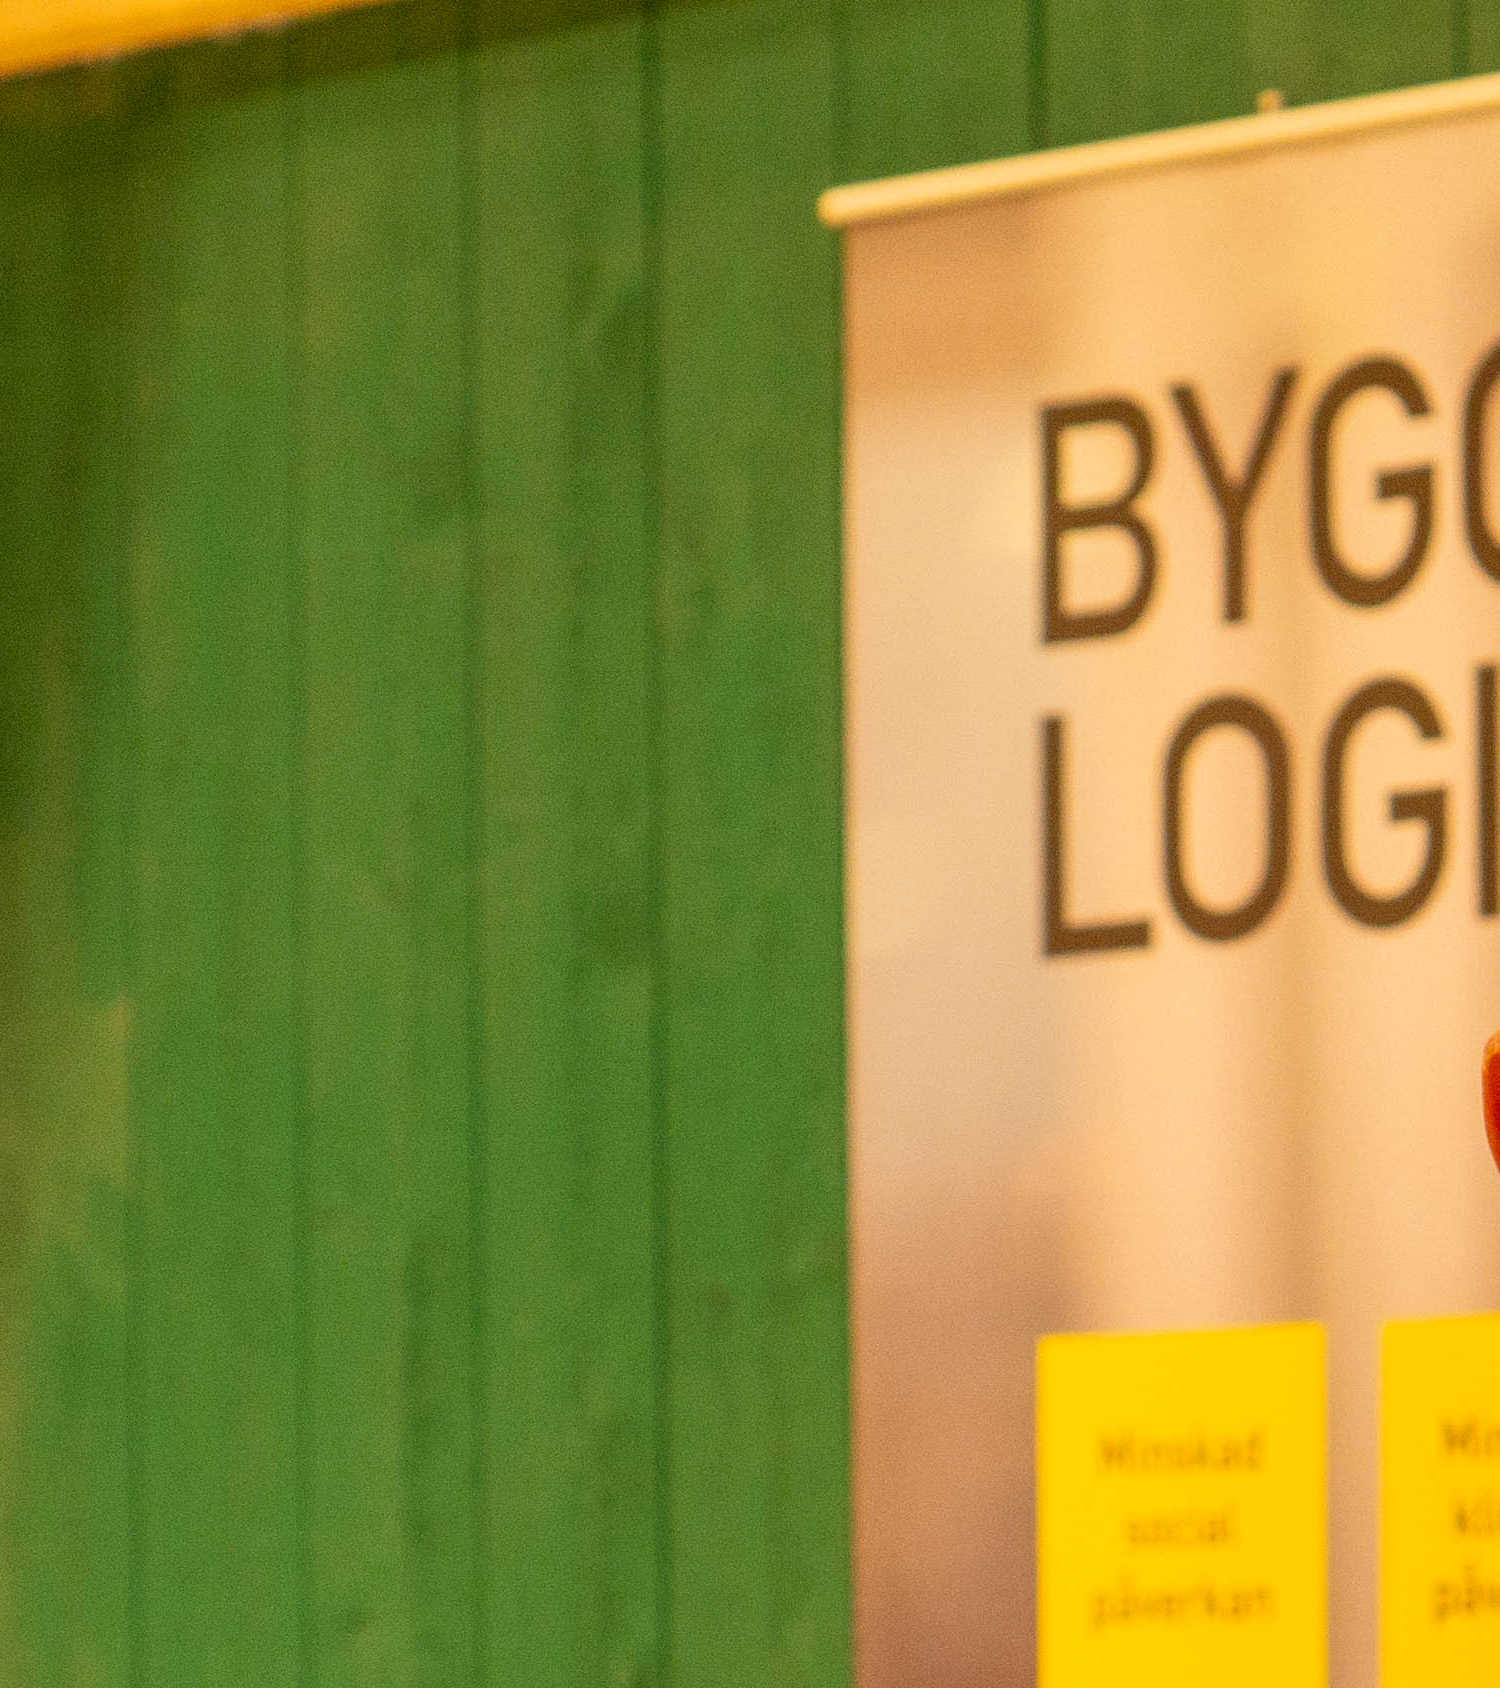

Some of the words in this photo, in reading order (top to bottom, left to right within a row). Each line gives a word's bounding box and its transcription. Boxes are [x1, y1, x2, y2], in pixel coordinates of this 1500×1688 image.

[1097, 1428, 1267, 1475] Minskad
[1123, 1500, 1241, 1550] social
[1088, 1570, 1277, 1634] påverkan
